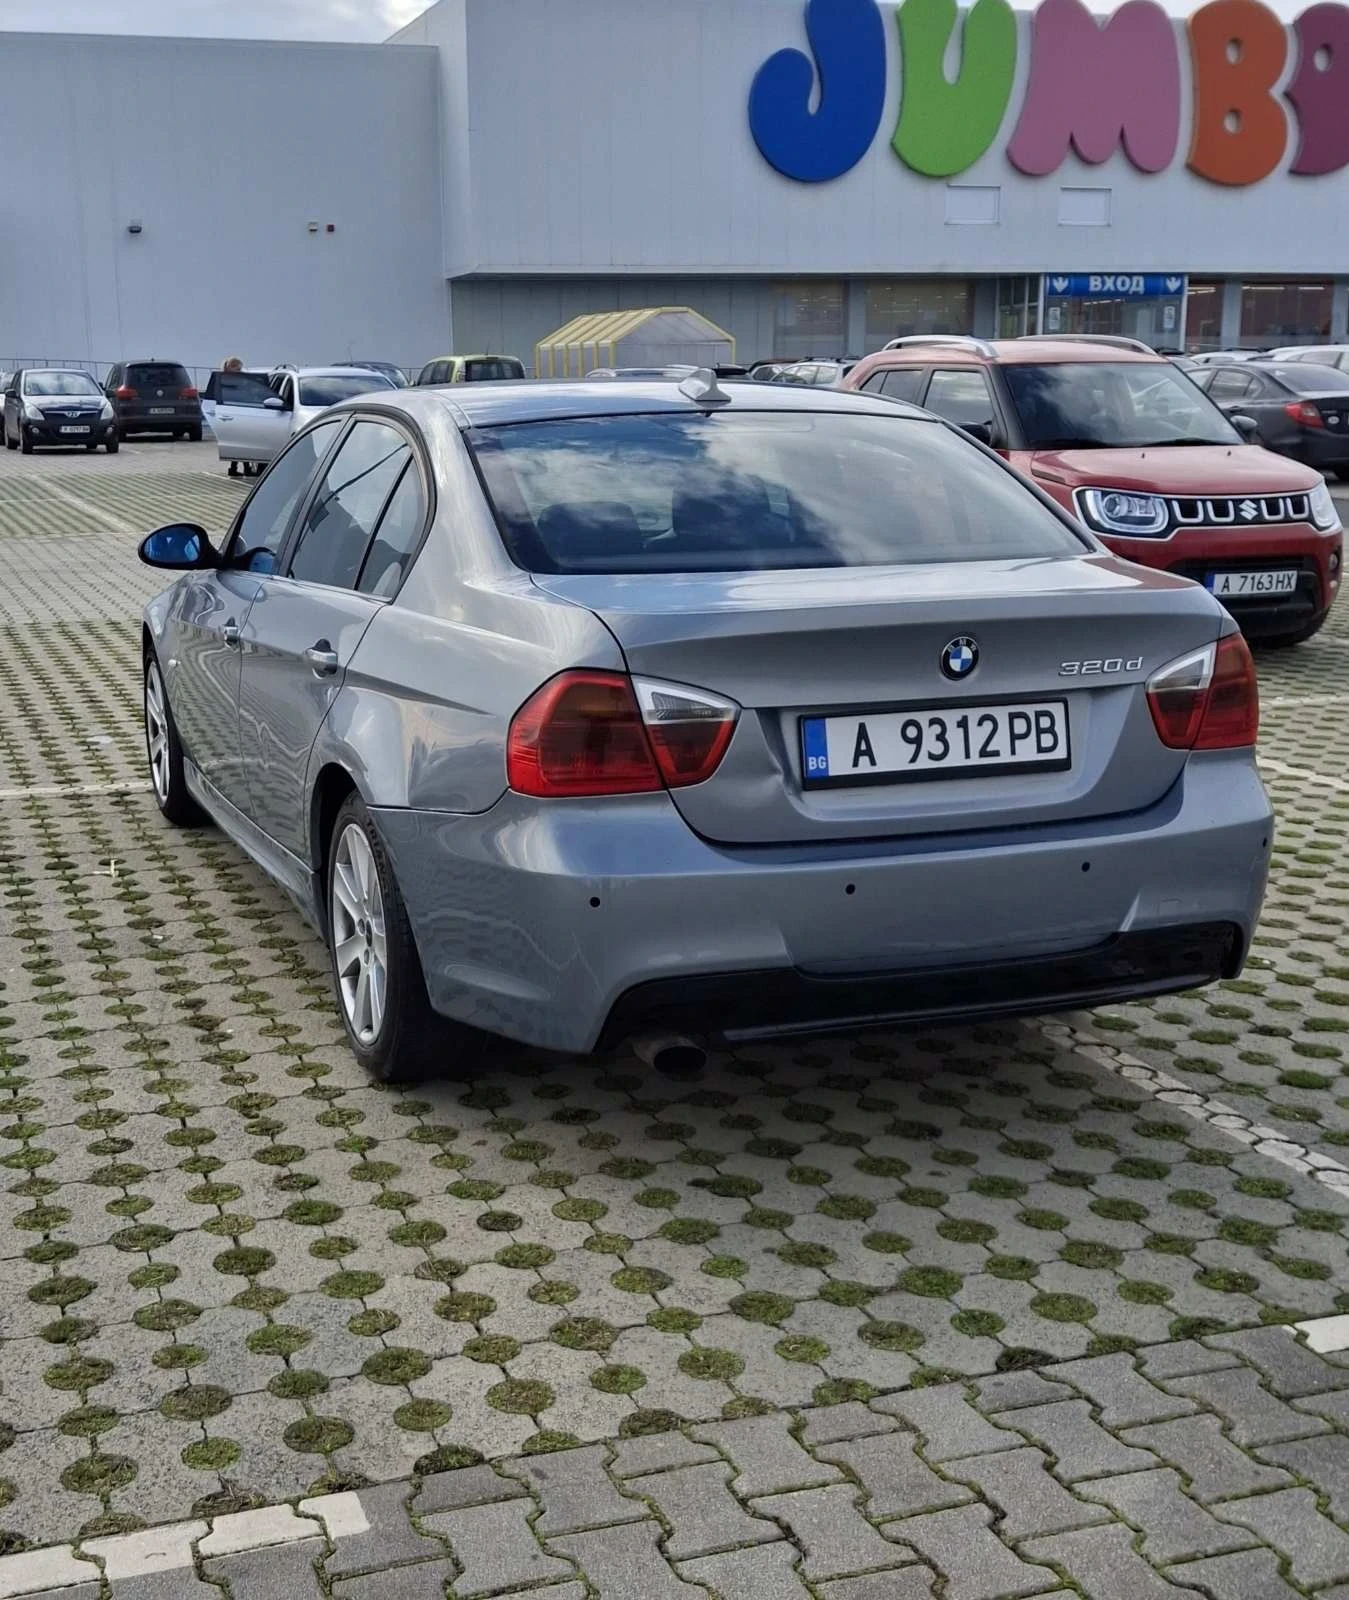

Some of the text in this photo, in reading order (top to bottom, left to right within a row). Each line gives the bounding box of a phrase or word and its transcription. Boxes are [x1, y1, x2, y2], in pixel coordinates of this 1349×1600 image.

[1088, 275, 1145, 295] ВХОД
[1220, 573, 1294, 593] A 7163HX
[1058, 656, 1144, 676] 320d
[851, 709, 1059, 768] A 9312PB
[808, 756, 827, 771] BG
